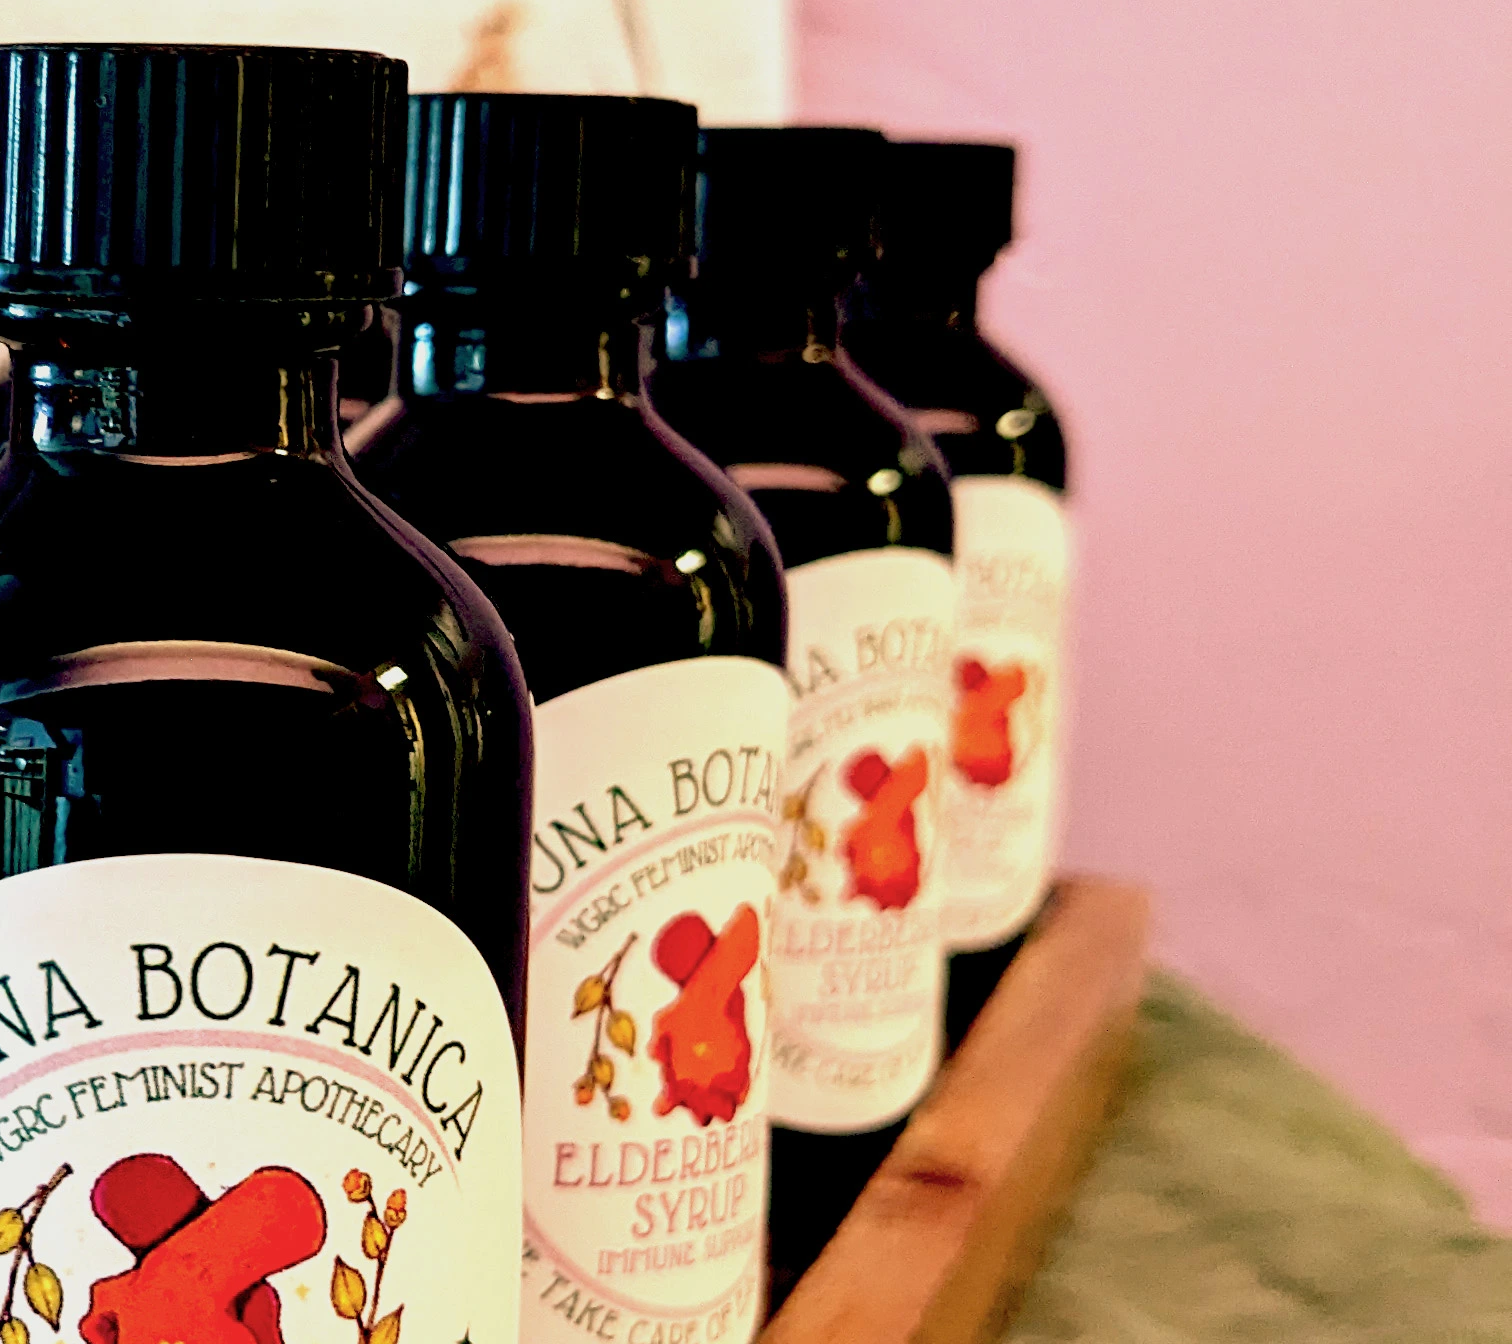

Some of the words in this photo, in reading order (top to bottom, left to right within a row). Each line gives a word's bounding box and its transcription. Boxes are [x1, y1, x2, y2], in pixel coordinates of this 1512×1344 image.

[532, 784, 654, 894] UNA
[555, 883, 634, 950] WGRC
[130, 942, 486, 1162] BOTANICA
[67, 1060, 245, 1123] FEMINIST
[250, 1065, 443, 1189] APOTHECARY
[631, 1172, 748, 1241] SYRUP
[597, 1239, 696, 1277] IMMUNE
[539, 1268, 618, 1343] TAKE
